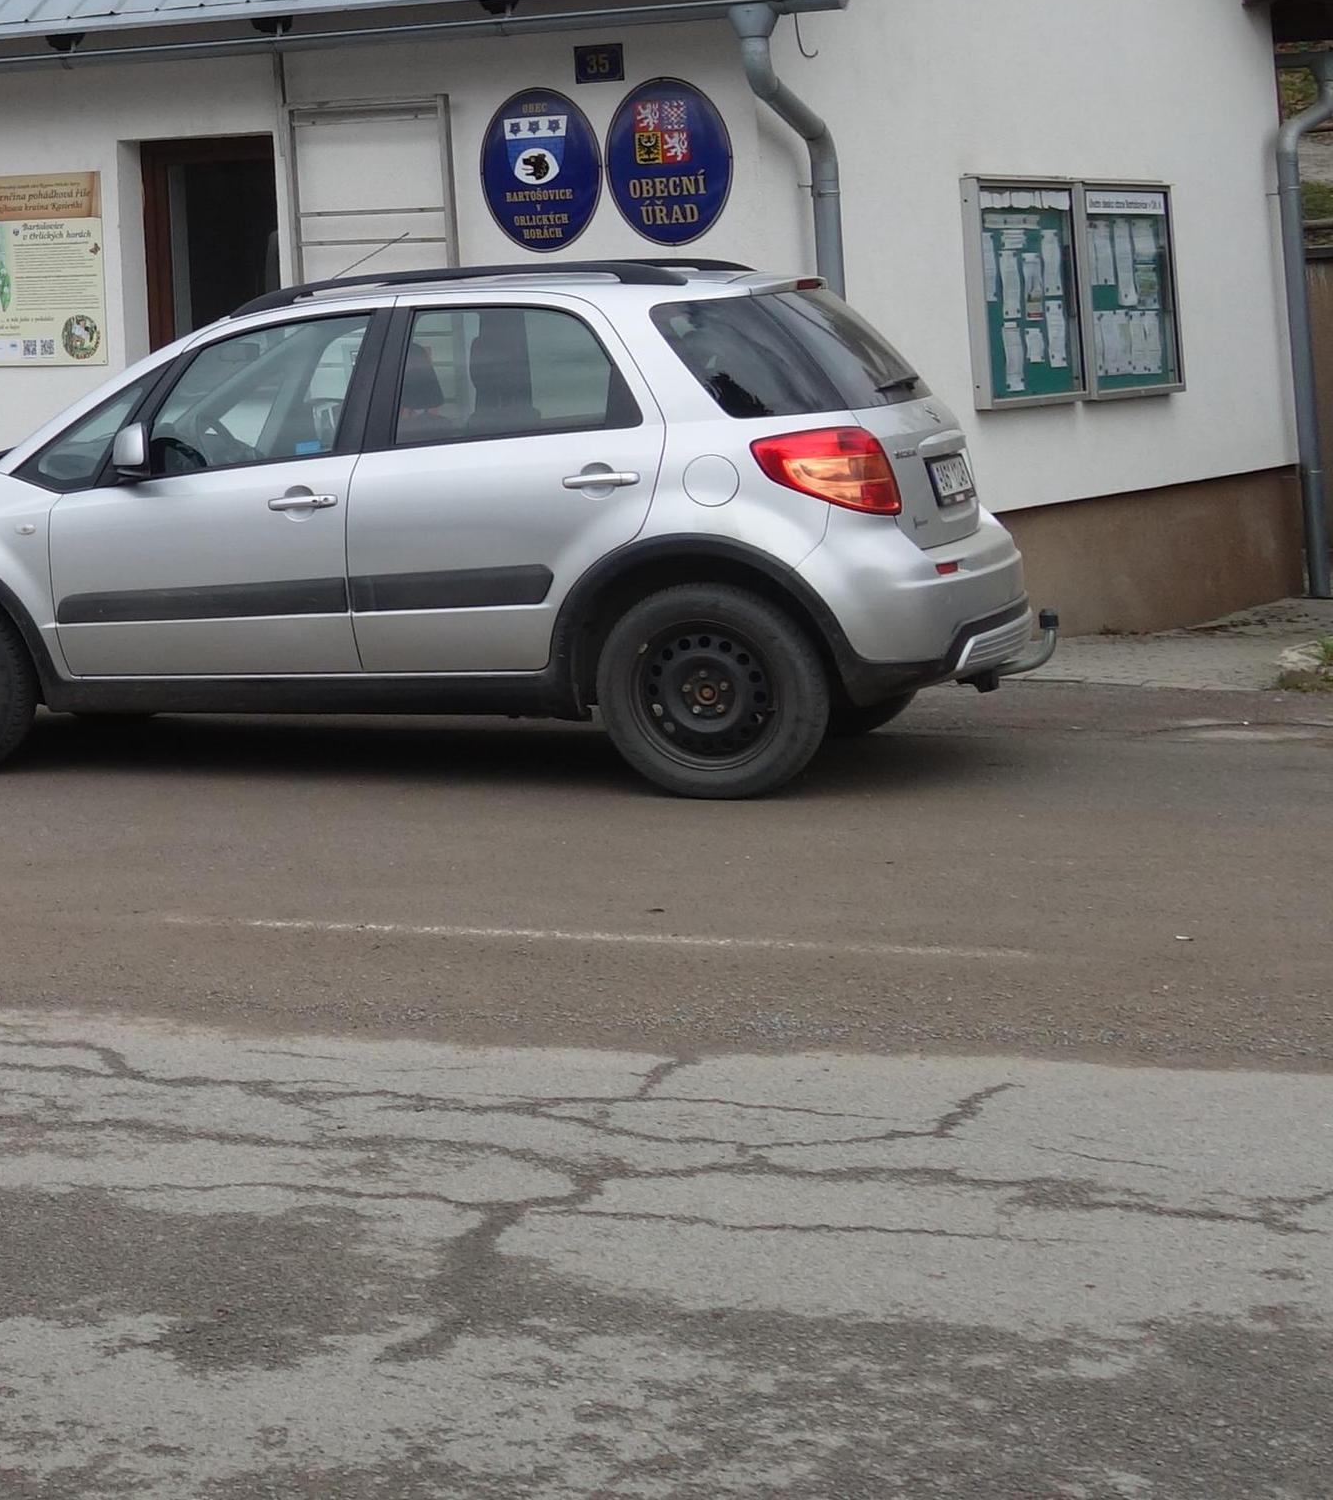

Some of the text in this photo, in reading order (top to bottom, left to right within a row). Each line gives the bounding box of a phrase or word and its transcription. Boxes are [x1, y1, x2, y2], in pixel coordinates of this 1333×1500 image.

[586, 54, 609, 74] 35
[522, 102, 548, 113] OBEC
[629, 169, 707, 198] OBECNÍ
[28, 189, 73, 202] pohádková
[506, 187, 573, 202] BARTOŠOVICE
[514, 211, 569, 226] ORLICKÝCH
[640, 200, 699, 225] ÚŘAD
[29, 231, 64, 242] Orlických
[65, 230, 91, 239] horách
[523, 226, 563, 240] HORÁCH
